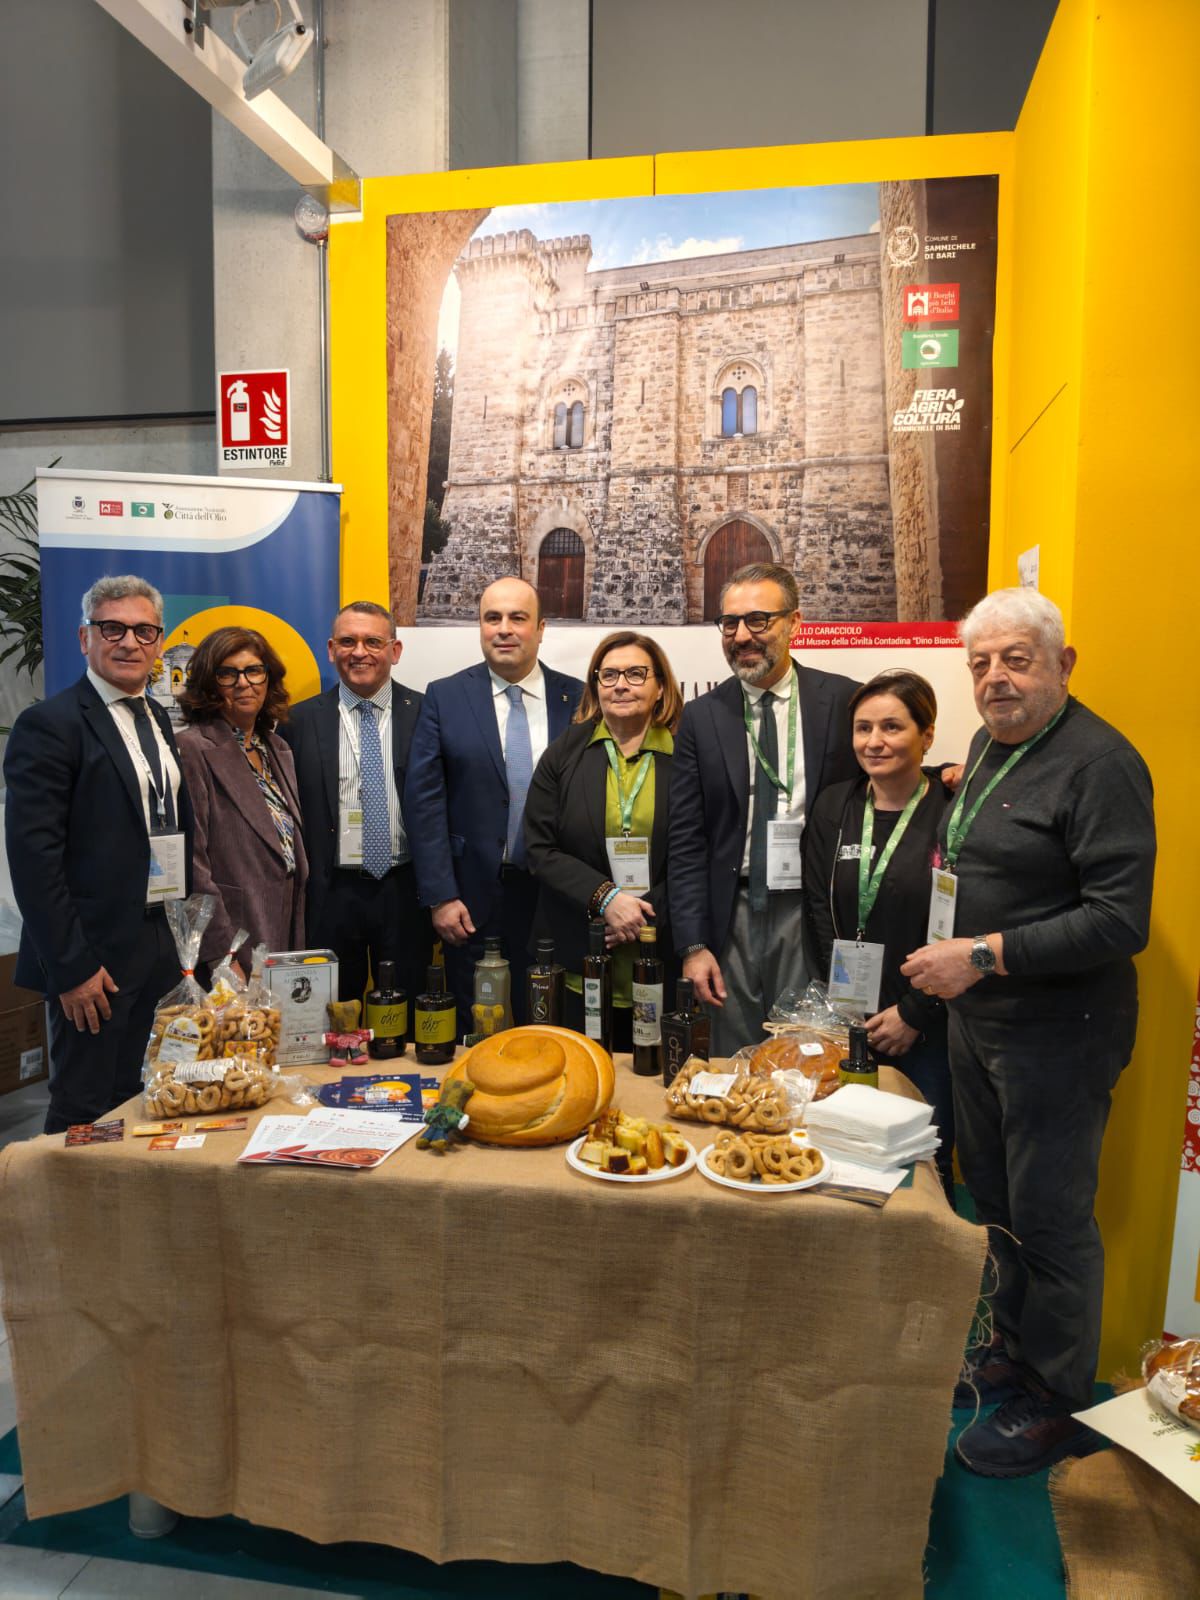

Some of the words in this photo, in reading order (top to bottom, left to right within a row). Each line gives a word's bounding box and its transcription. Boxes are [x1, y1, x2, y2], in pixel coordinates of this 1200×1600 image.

[925, 243, 976, 251] SAMMICHELE
[936, 252, 956, 260] BARI
[933, 290, 955, 300] Borghi
[940, 298, 956, 306] belli
[913, 388, 956, 401] FIERA
[907, 401, 944, 413] AGRI
[893, 412, 960, 426] COLTURA
[224, 447, 287, 461] ESTINTORE
[815, 626, 862, 635] CARACCIOLO
[794, 638, 805, 646] del
[807, 638, 830, 646] Museo
[831, 637, 849, 645] della
[850, 636, 873, 645] Civiltà
[874, 637, 911, 645] Contadina
